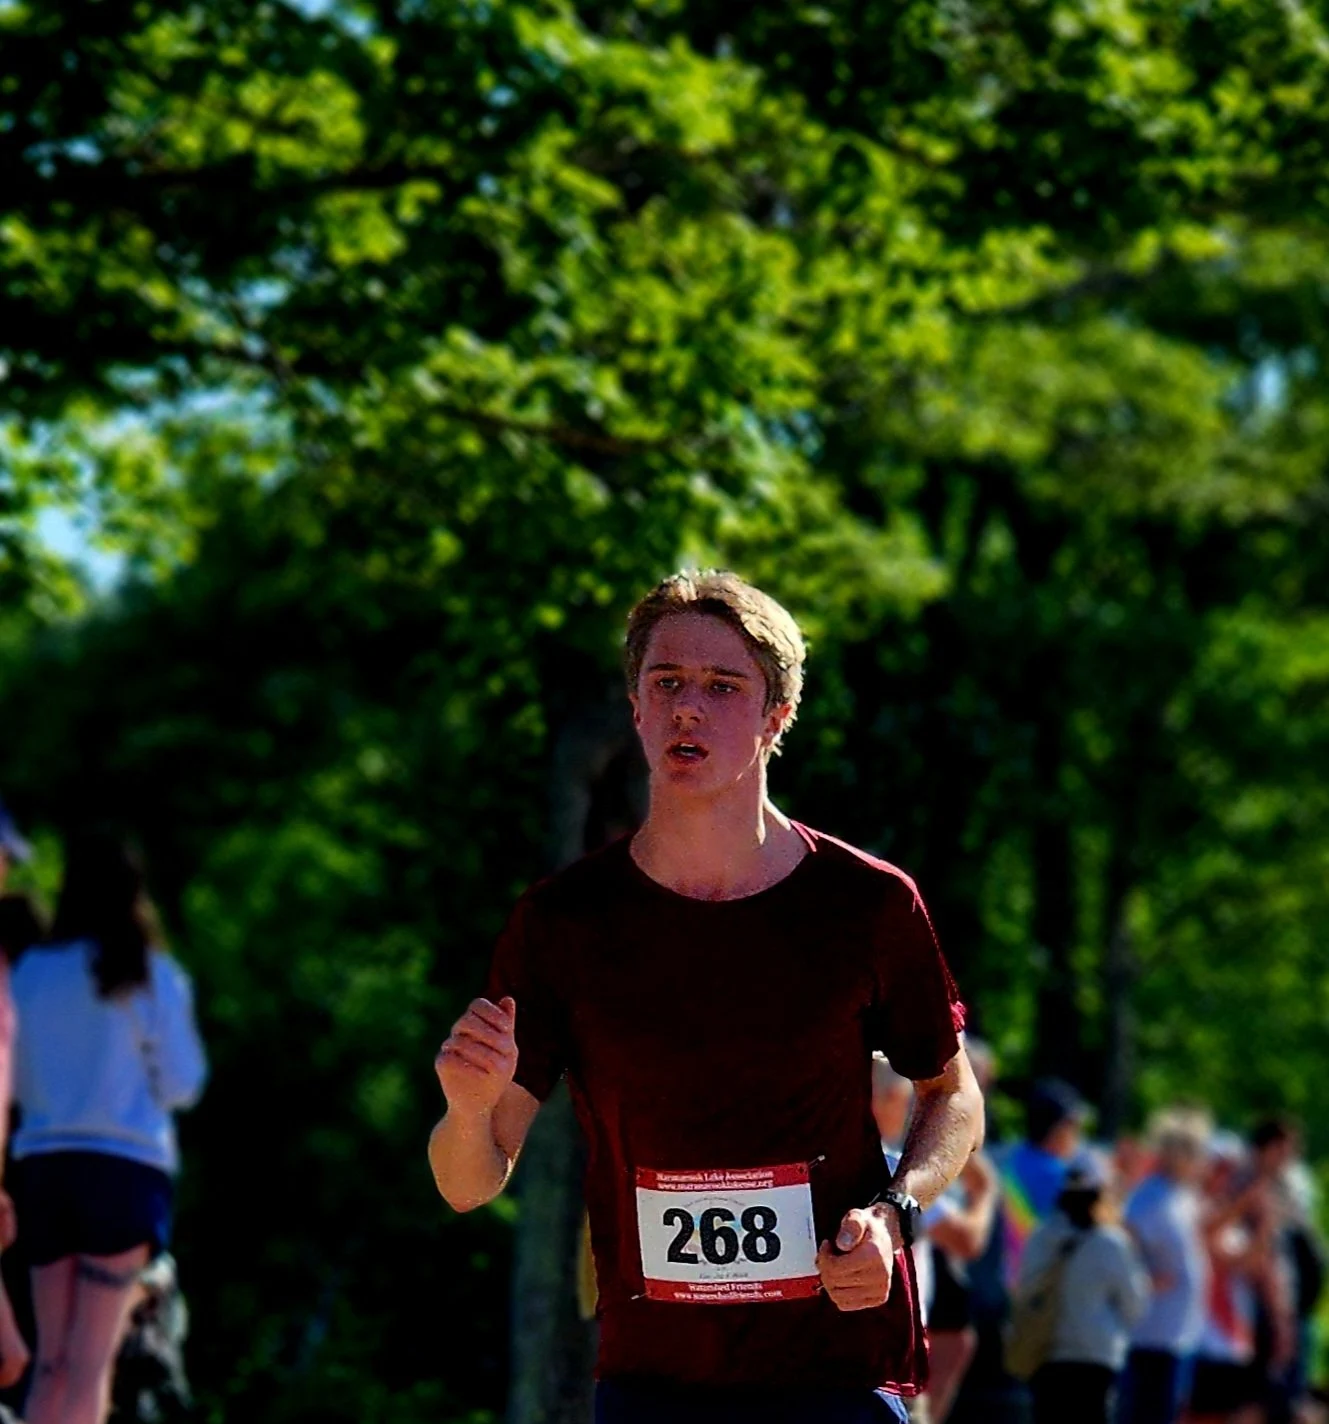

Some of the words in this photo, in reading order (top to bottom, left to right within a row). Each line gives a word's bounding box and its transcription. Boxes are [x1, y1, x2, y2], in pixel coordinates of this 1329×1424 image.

[704, 1172, 725, 1181] Lake
[725, 1171, 774, 1181] Association
[663, 1206, 781, 1265] 268
[731, 1282, 763, 1291] Friends
